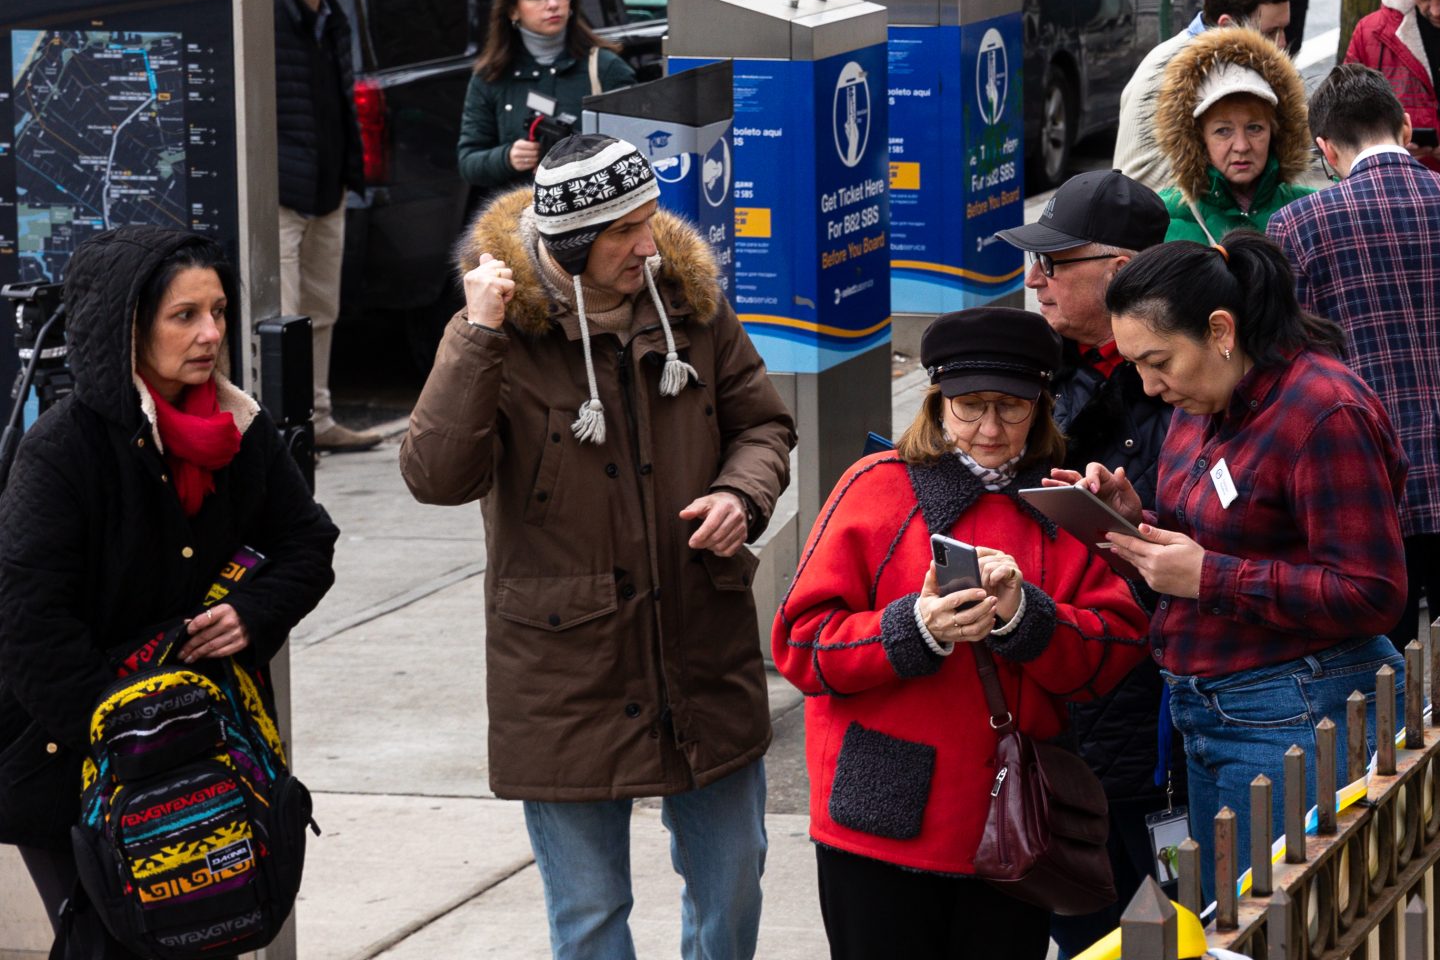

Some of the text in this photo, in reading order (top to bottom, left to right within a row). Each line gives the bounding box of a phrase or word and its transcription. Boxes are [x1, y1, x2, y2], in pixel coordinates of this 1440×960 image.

[733, 127, 761, 137] boleto
[1000, 161, 1016, 182] SBS
[821, 177, 884, 214] Get Ticket Here
[966, 200, 988, 221] Before
[988, 193, 1000, 212] You
[1001, 186, 1020, 208] Board
[709, 224, 725, 244] Get
[828, 220, 843, 241] For
[844, 213, 861, 236] B82
[861, 205, 879, 228] SBS
[821, 232, 885, 270] Before You Board
[211, 847, 248, 866] DAKINE
